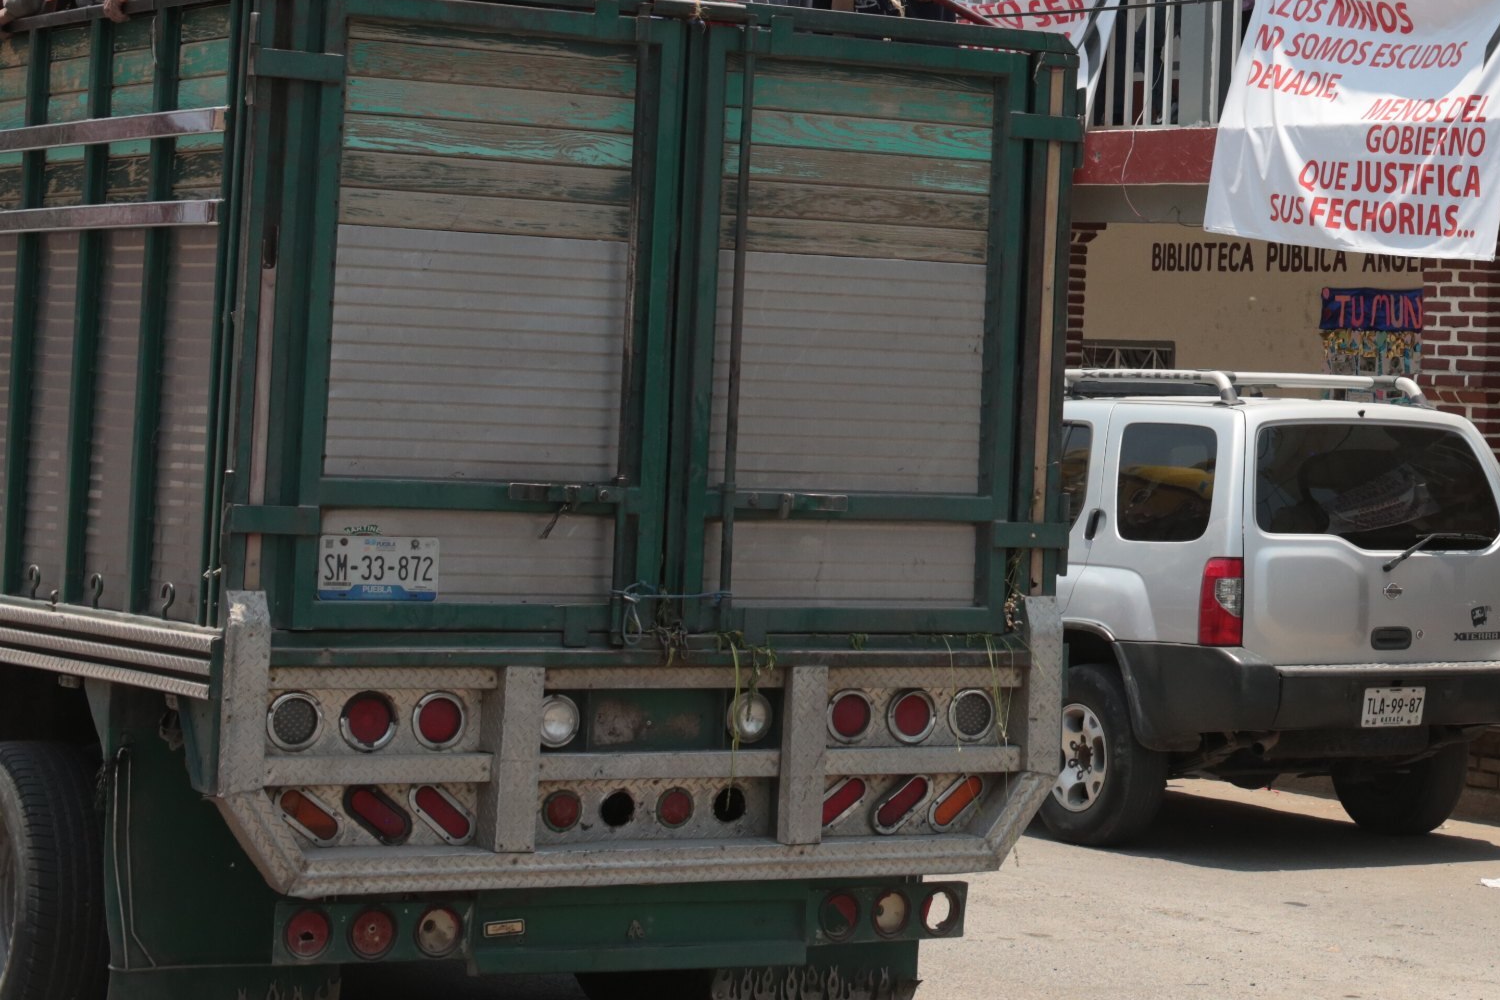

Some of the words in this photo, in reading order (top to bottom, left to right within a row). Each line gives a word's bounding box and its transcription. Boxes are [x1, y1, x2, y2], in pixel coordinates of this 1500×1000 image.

[1255, 24, 1285, 52] NO
[1284, 33, 1372, 65] SOMOS
[1369, 41, 1468, 69] ESCUDOS
[1360, 98, 1446, 123] MENOS
[1445, 94, 1490, 123] DEL
[1366, 125, 1487, 157] GOBIERNO
[1298, 159, 1347, 192] QUE
[1351, 161, 1482, 198] JUSTIFICA
[1270, 193, 1305, 225] SUS
[1309, 197, 1475, 239] FECHORIAS...
[1152, 242, 1254, 272] BIBLIOTECA
[1266, 242, 1347, 272] PUBLICA
[1334, 295, 1365, 328] TU
[324, 553, 434, 581] SM-33-872
[362, 585, 392, 593] PUEBLA
[1367, 697, 1423, 715] TLA-99-87
